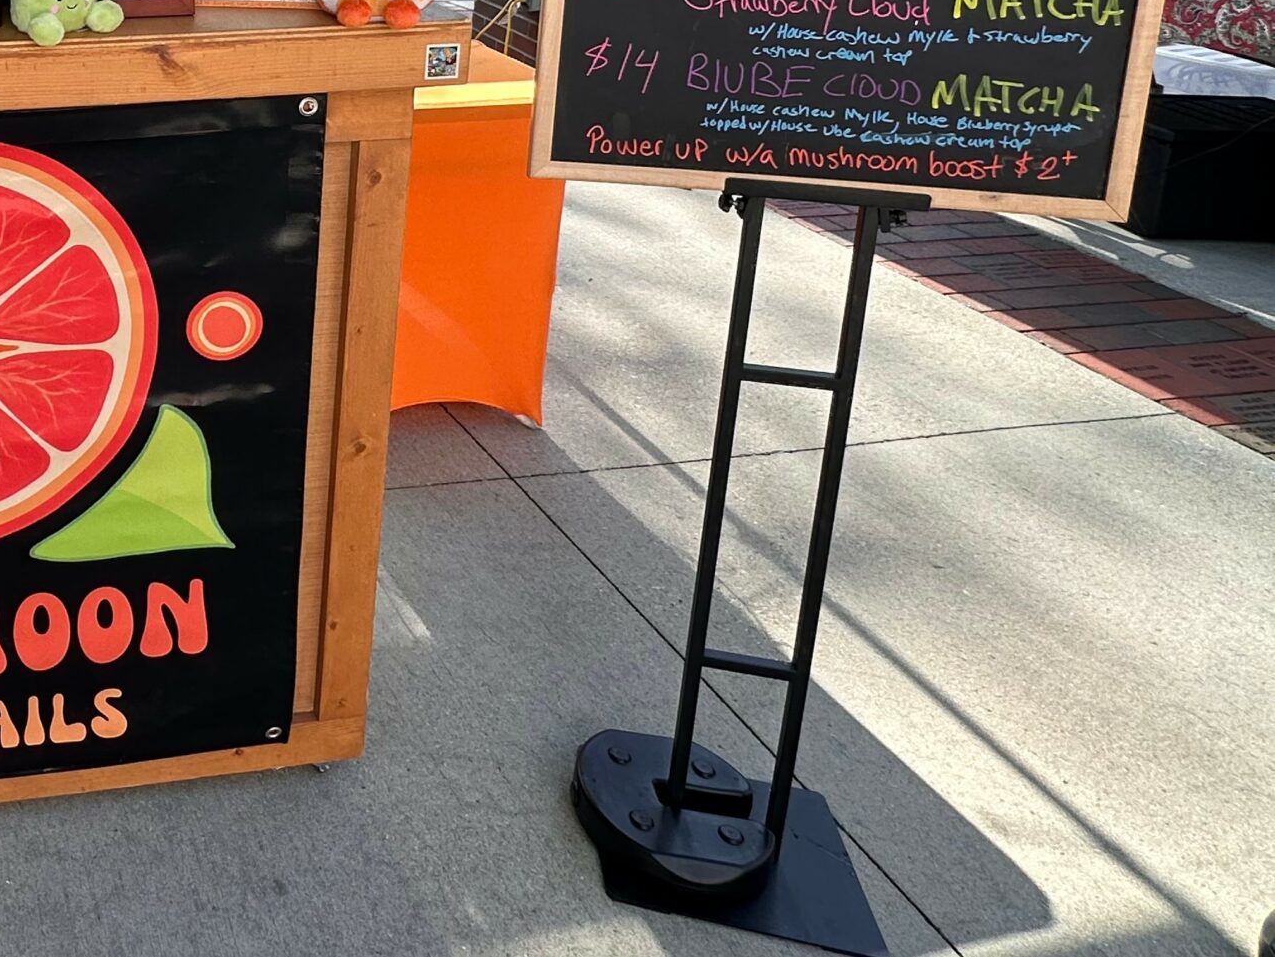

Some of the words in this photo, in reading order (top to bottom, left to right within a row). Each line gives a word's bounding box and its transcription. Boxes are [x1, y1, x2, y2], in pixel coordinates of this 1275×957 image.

[825, 26, 900, 45] cashew
[752, 45, 810, 60] cashew
[584, 36, 659, 94] $14
[931, 73, 1101, 122] MATCHA
[772, 104, 835, 118] cashew
[906, 112, 950, 128] House
[586, 125, 663, 156] Power
[929, 150, 1004, 180] boost
[935, 133, 995, 148] cream
[998, 135, 1032, 152] top
